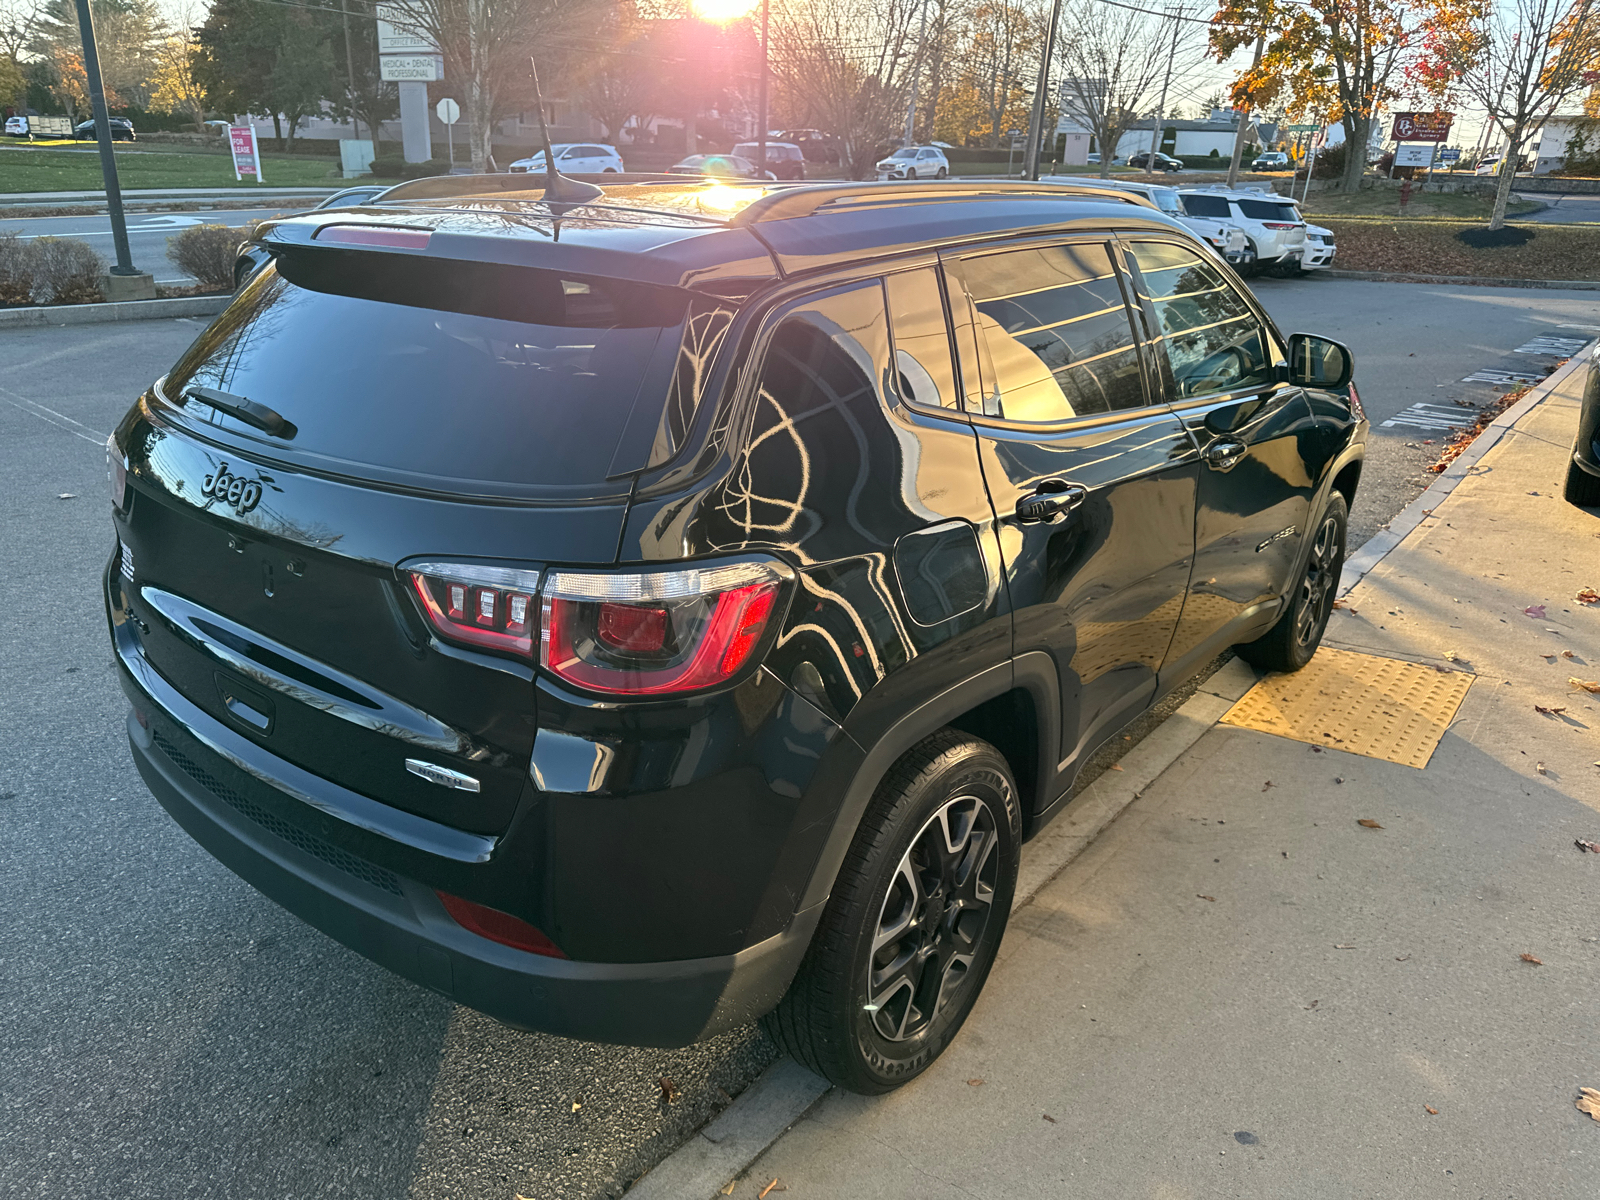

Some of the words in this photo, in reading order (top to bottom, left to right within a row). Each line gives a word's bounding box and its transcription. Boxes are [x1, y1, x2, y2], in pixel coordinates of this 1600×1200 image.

[382, 59, 406, 68] MEDICAL
[412, 59, 434, 68] DENTAL
[387, 69, 429, 78] PROFESSIONAL
[234, 146, 251, 154] LEASE
[201, 461, 263, 517] Jeep
[418, 767, 462, 786] NORTH
